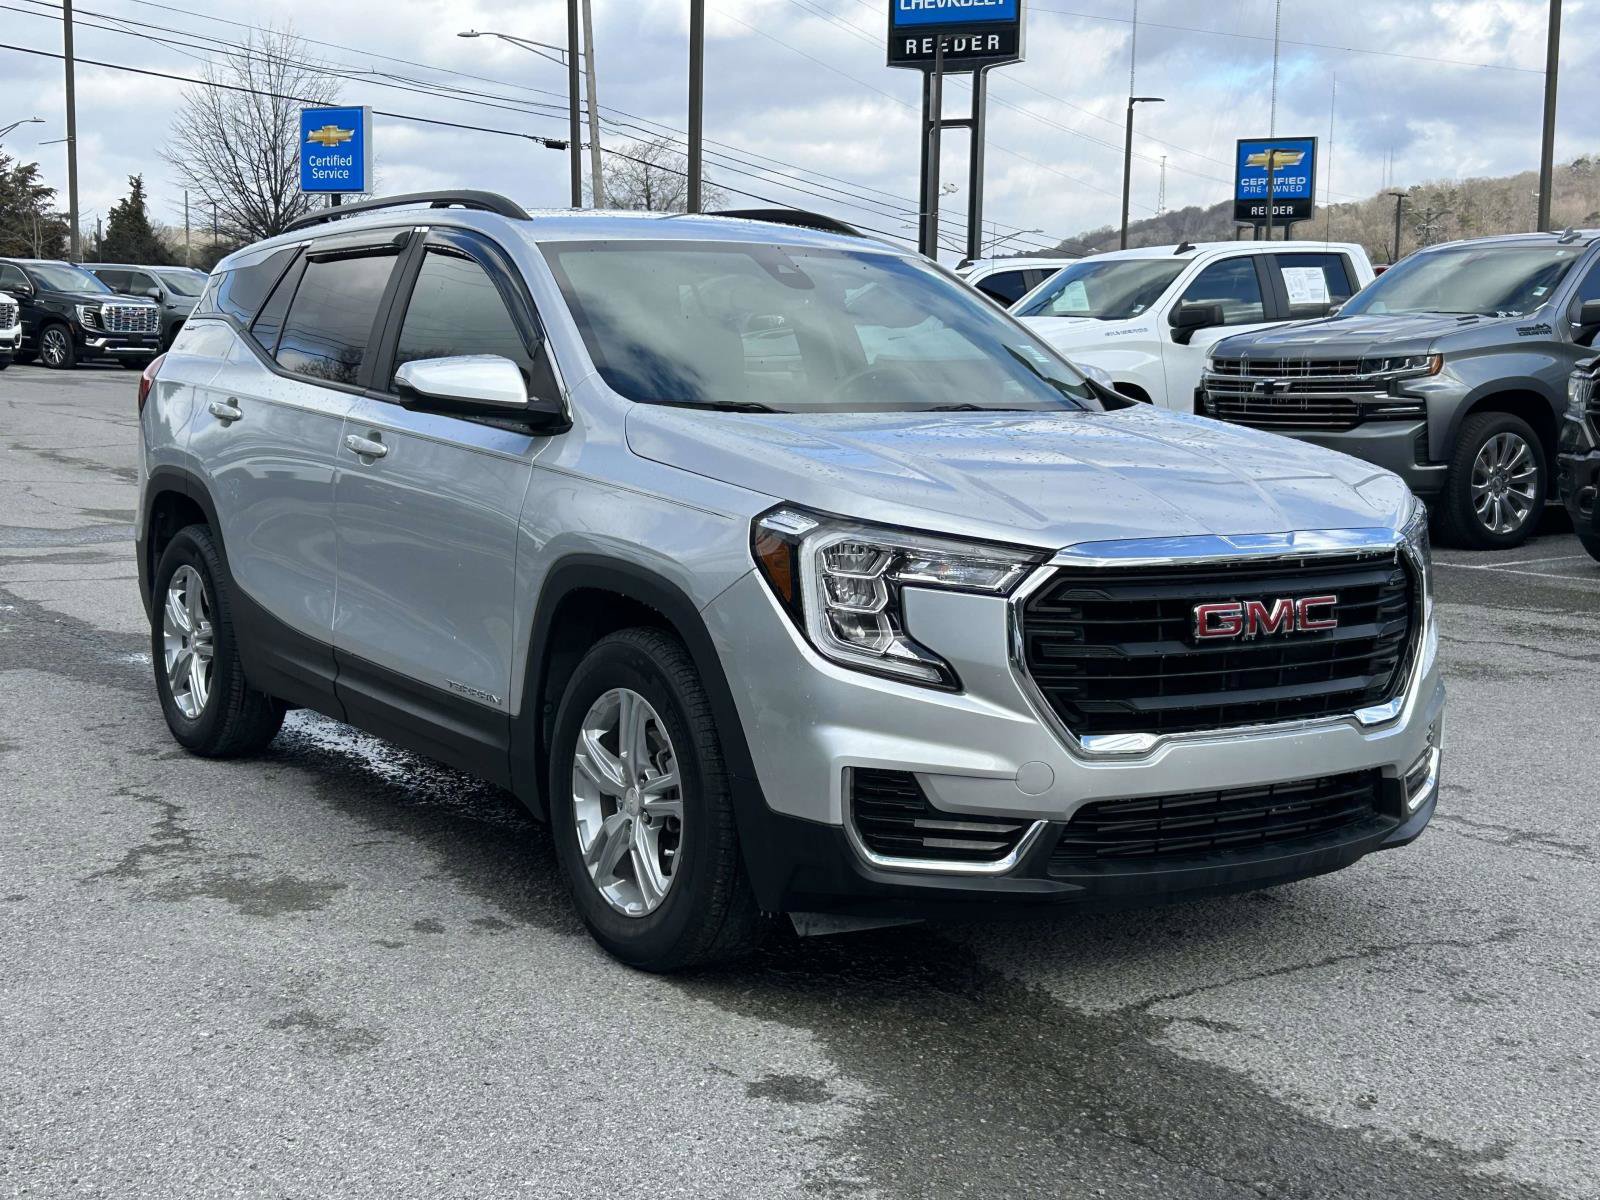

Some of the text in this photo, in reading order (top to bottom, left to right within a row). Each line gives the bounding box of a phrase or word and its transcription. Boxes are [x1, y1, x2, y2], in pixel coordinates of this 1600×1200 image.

[309, 154, 352, 167] Certified
[312, 167, 349, 179] Service
[1241, 177, 1306, 186] CERIFIED
[1244, 185, 1303, 193] PRE-WNED
[1194, 595, 1338, 640] GMC
